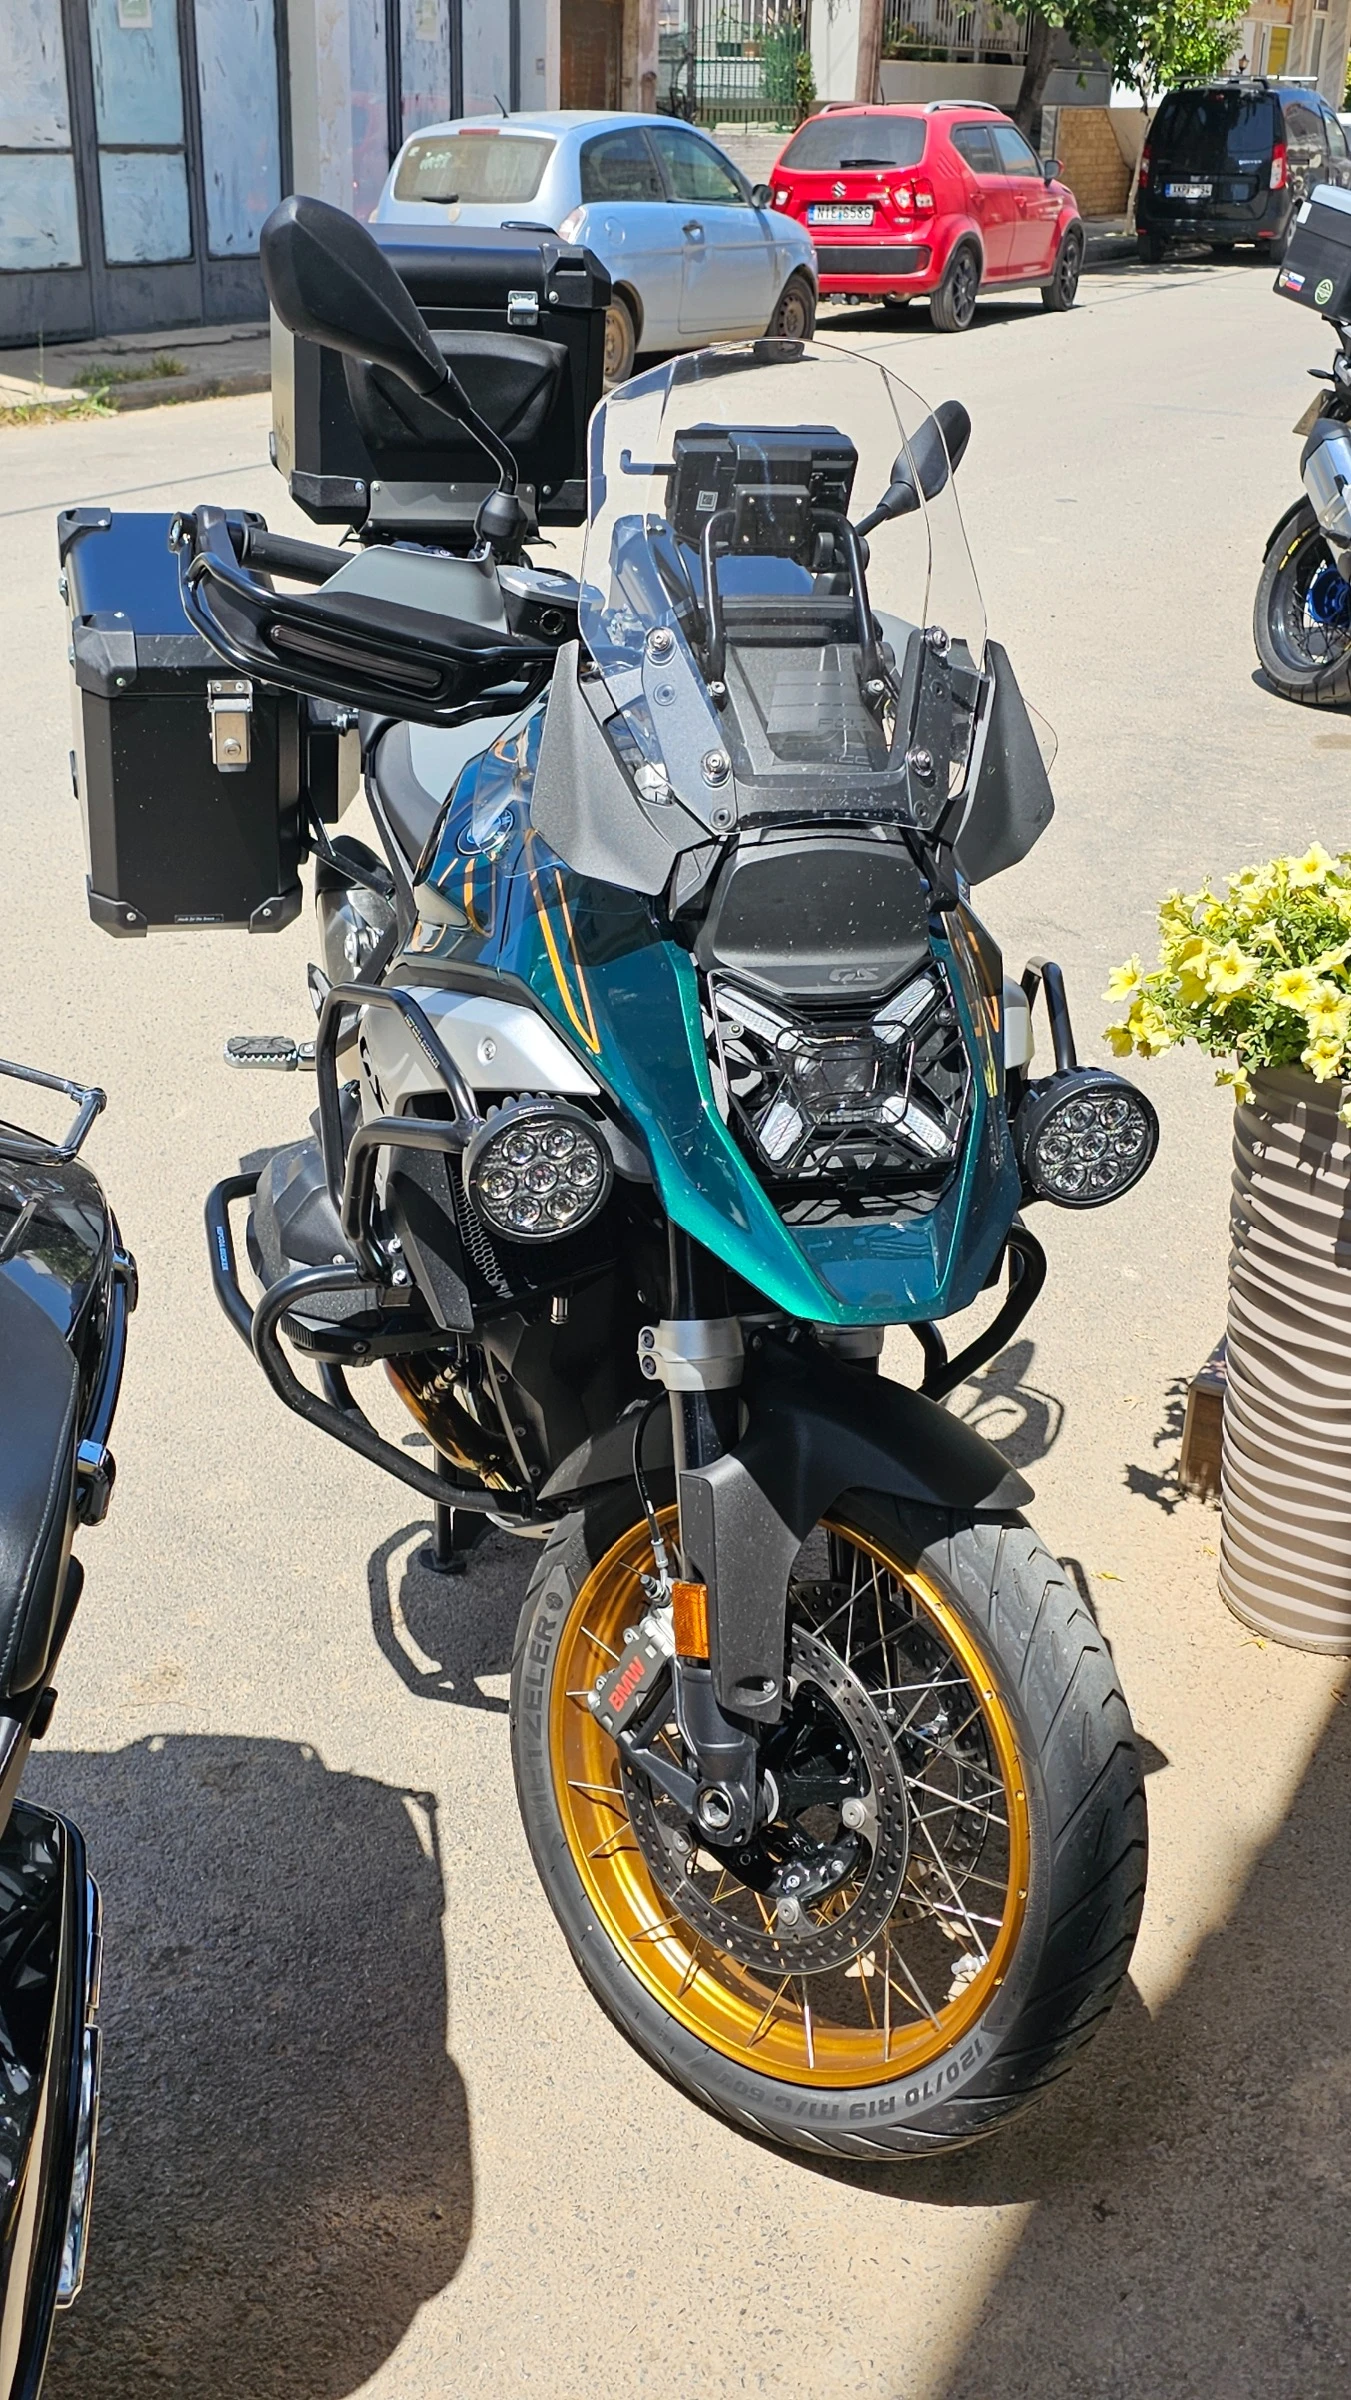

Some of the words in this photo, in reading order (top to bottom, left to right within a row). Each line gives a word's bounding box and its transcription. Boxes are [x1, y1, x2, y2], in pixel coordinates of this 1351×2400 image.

[829, 968, 878, 982] GS
[518, 1105, 555, 1115] DENALI
[608, 1655, 646, 1713] BMW
[523, 1615, 558, 1826] METZELER
[905, 2037, 984, 2107] 120/70
[850, 2095, 896, 2121] R19
